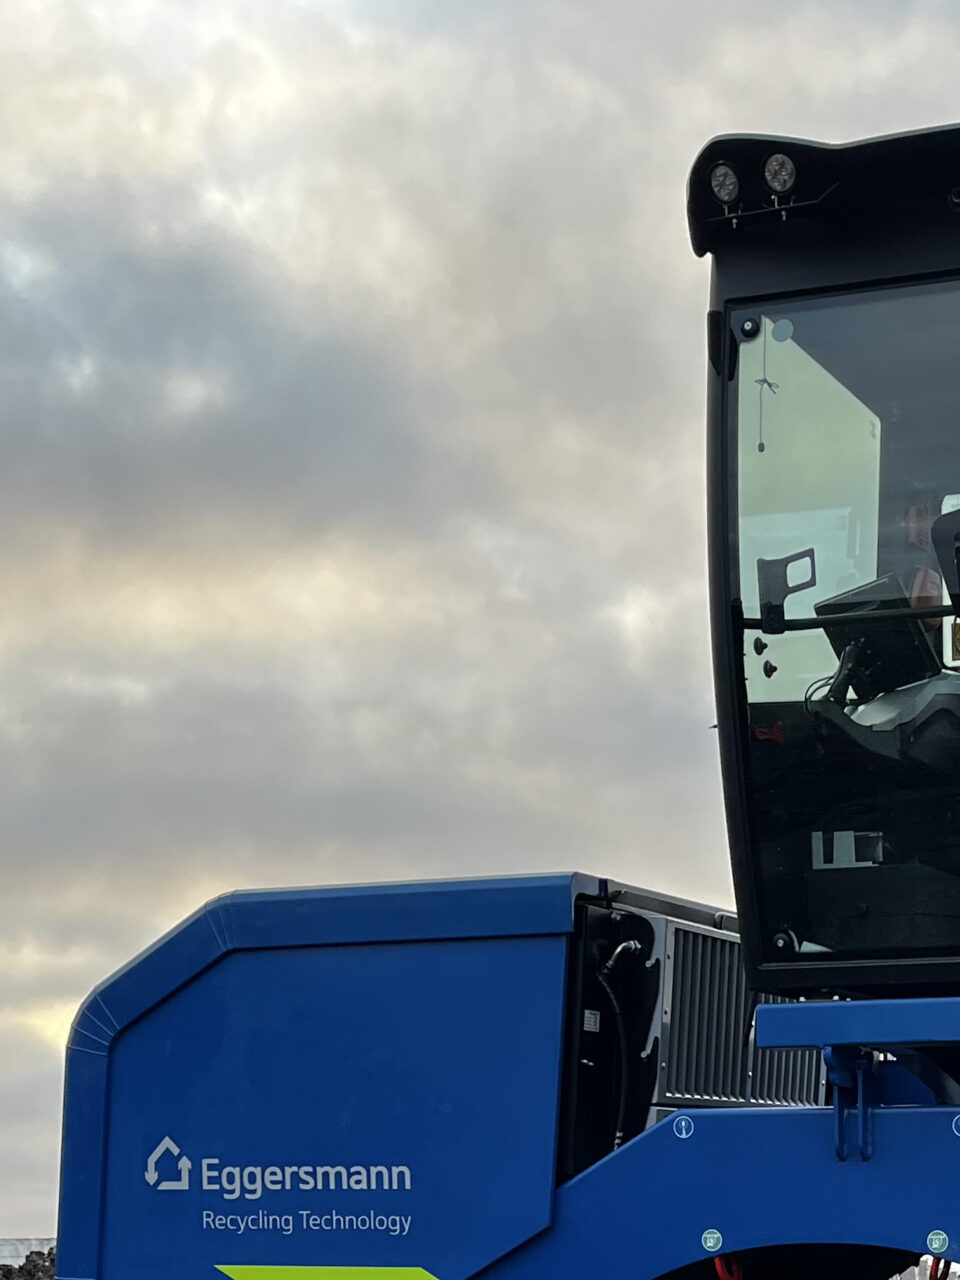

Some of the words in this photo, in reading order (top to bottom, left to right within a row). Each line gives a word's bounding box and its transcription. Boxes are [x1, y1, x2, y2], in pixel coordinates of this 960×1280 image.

[201, 1158, 412, 1200] Eggersmann
[202, 1209, 294, 1235] Recycling
[298, 1209, 412, 1236] Technology
